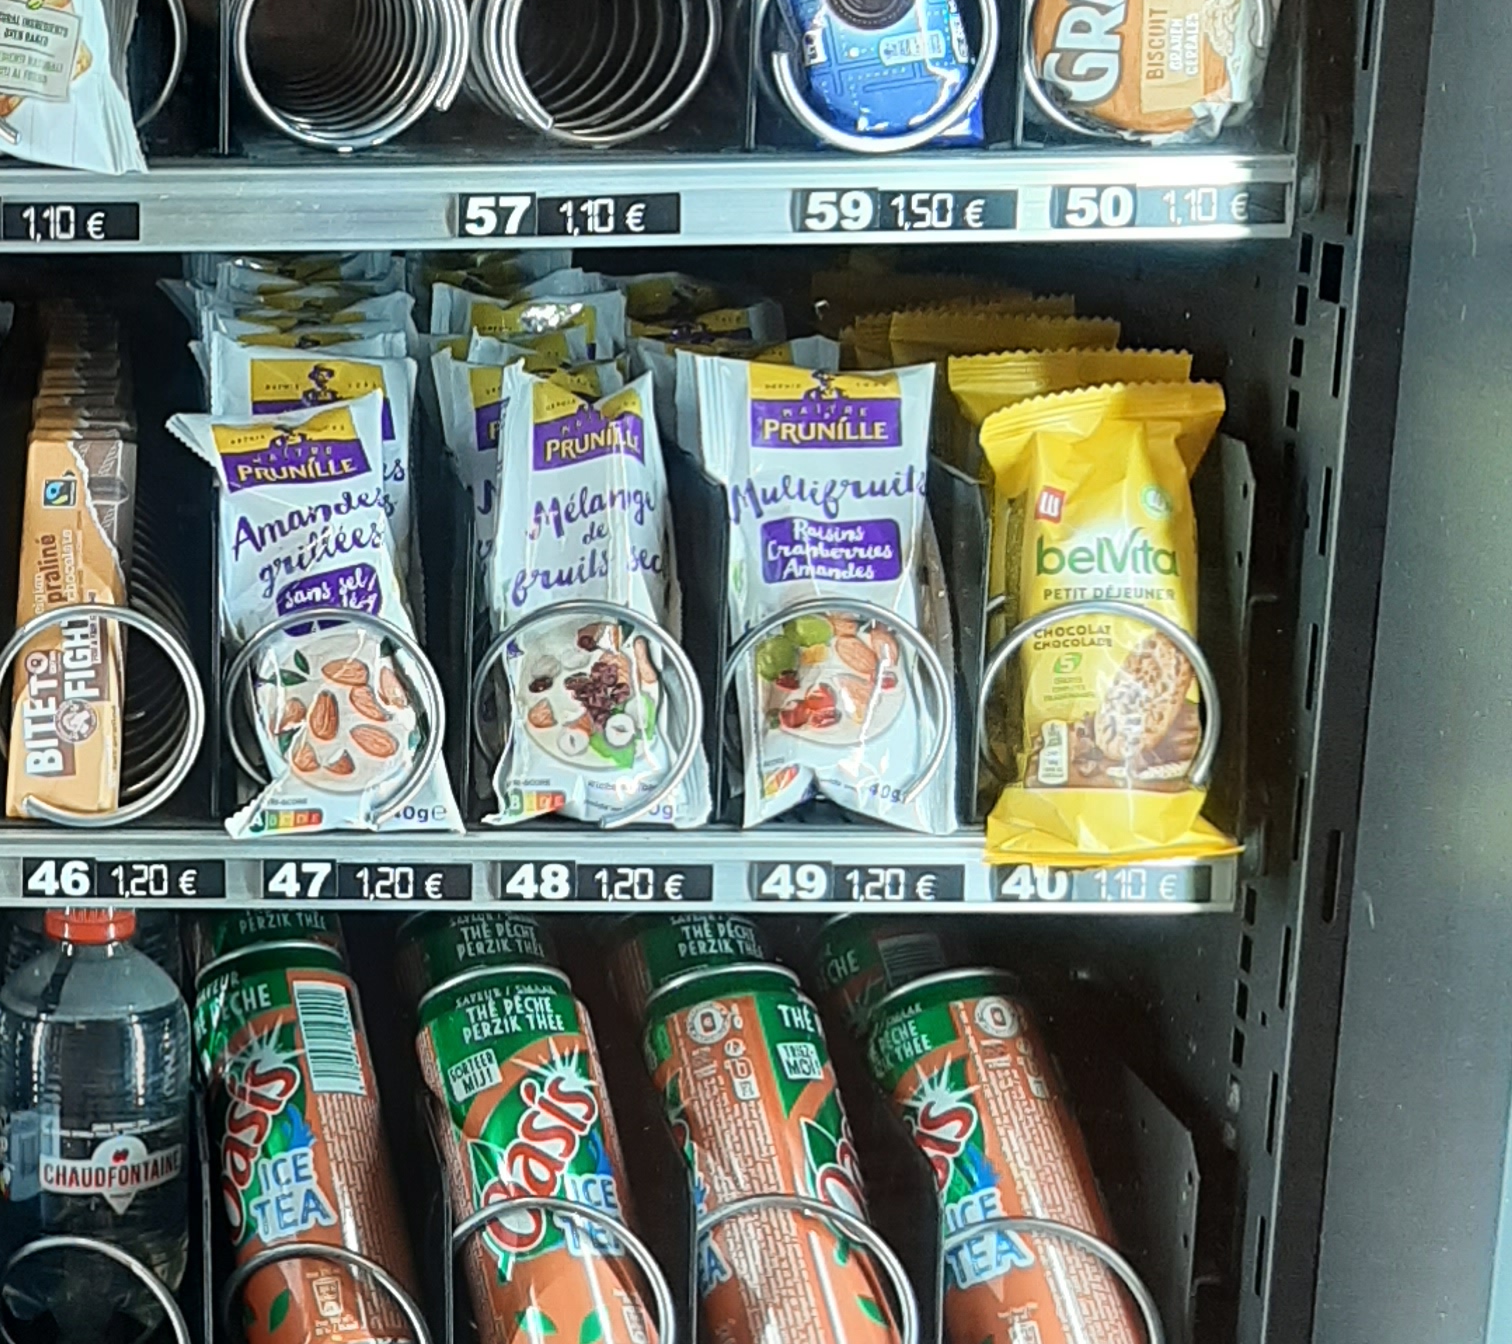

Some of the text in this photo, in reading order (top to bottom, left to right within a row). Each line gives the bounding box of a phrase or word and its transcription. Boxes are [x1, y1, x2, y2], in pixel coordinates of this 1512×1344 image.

[1145, 7, 1169, 81] BISCUIT
[22, 205, 105, 243] 1,10 €
[464, 196, 531, 236] 57
[804, 189, 873, 230] 59
[890, 192, 985, 231] 1,50 €
[1065, 186, 1134, 227] 50
[731, 463, 928, 526] Multifruits
[232, 487, 397, 562] Amandes
[792, 518, 865, 542] Raisins
[35, 534, 66, 604] praliné
[767, 539, 894, 563] Cranberries
[783, 557, 875, 582] Amandes
[1035, 525, 1180, 577] belVita
[1043, 583, 1176, 601] PETIT DÉJEUNER
[1033, 623, 1112, 639] CHOCOLAT
[28, 860, 91, 897] 46
[268, 862, 332, 899] 47
[355, 867, 443, 901] 1,20 €
[505, 862, 570, 899] 48
[761, 864, 828, 901] 49
[504, 994, 553, 1018] PÊCHE
[777, 1002, 816, 1033] THÉ
[463, 1013, 565, 1044] PERZIK THEE
[449, 1051, 495, 1084] SORTEER
[42, 1151, 182, 1188] CHAUDFONTAINE
[259, 1158, 312, 1187] ICE
[487, 1056, 599, 1253] Oasis
[254, 1195, 330, 1235] TEA
[946, 1191, 997, 1231] ICE
[946, 1234, 1026, 1284] TEA
